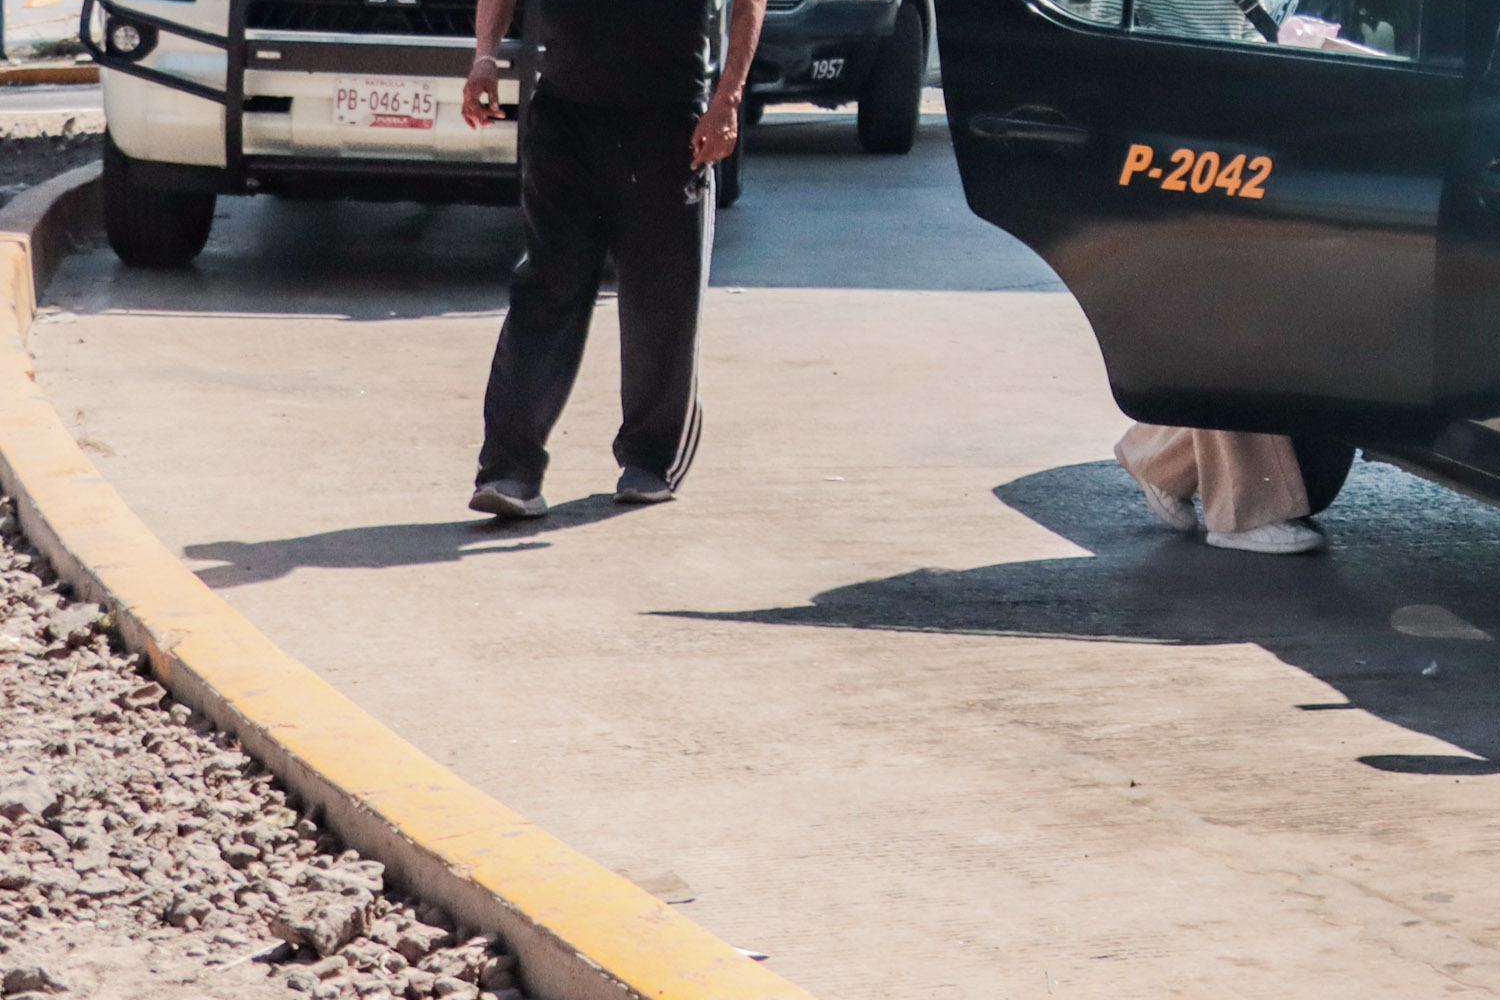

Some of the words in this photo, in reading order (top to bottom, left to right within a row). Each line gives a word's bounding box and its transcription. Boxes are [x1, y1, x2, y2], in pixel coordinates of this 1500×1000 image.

[812, 59, 844, 79] 1957
[337, 89, 432, 113] PB-046-A5
[1119, 143, 1273, 199] P-2042
